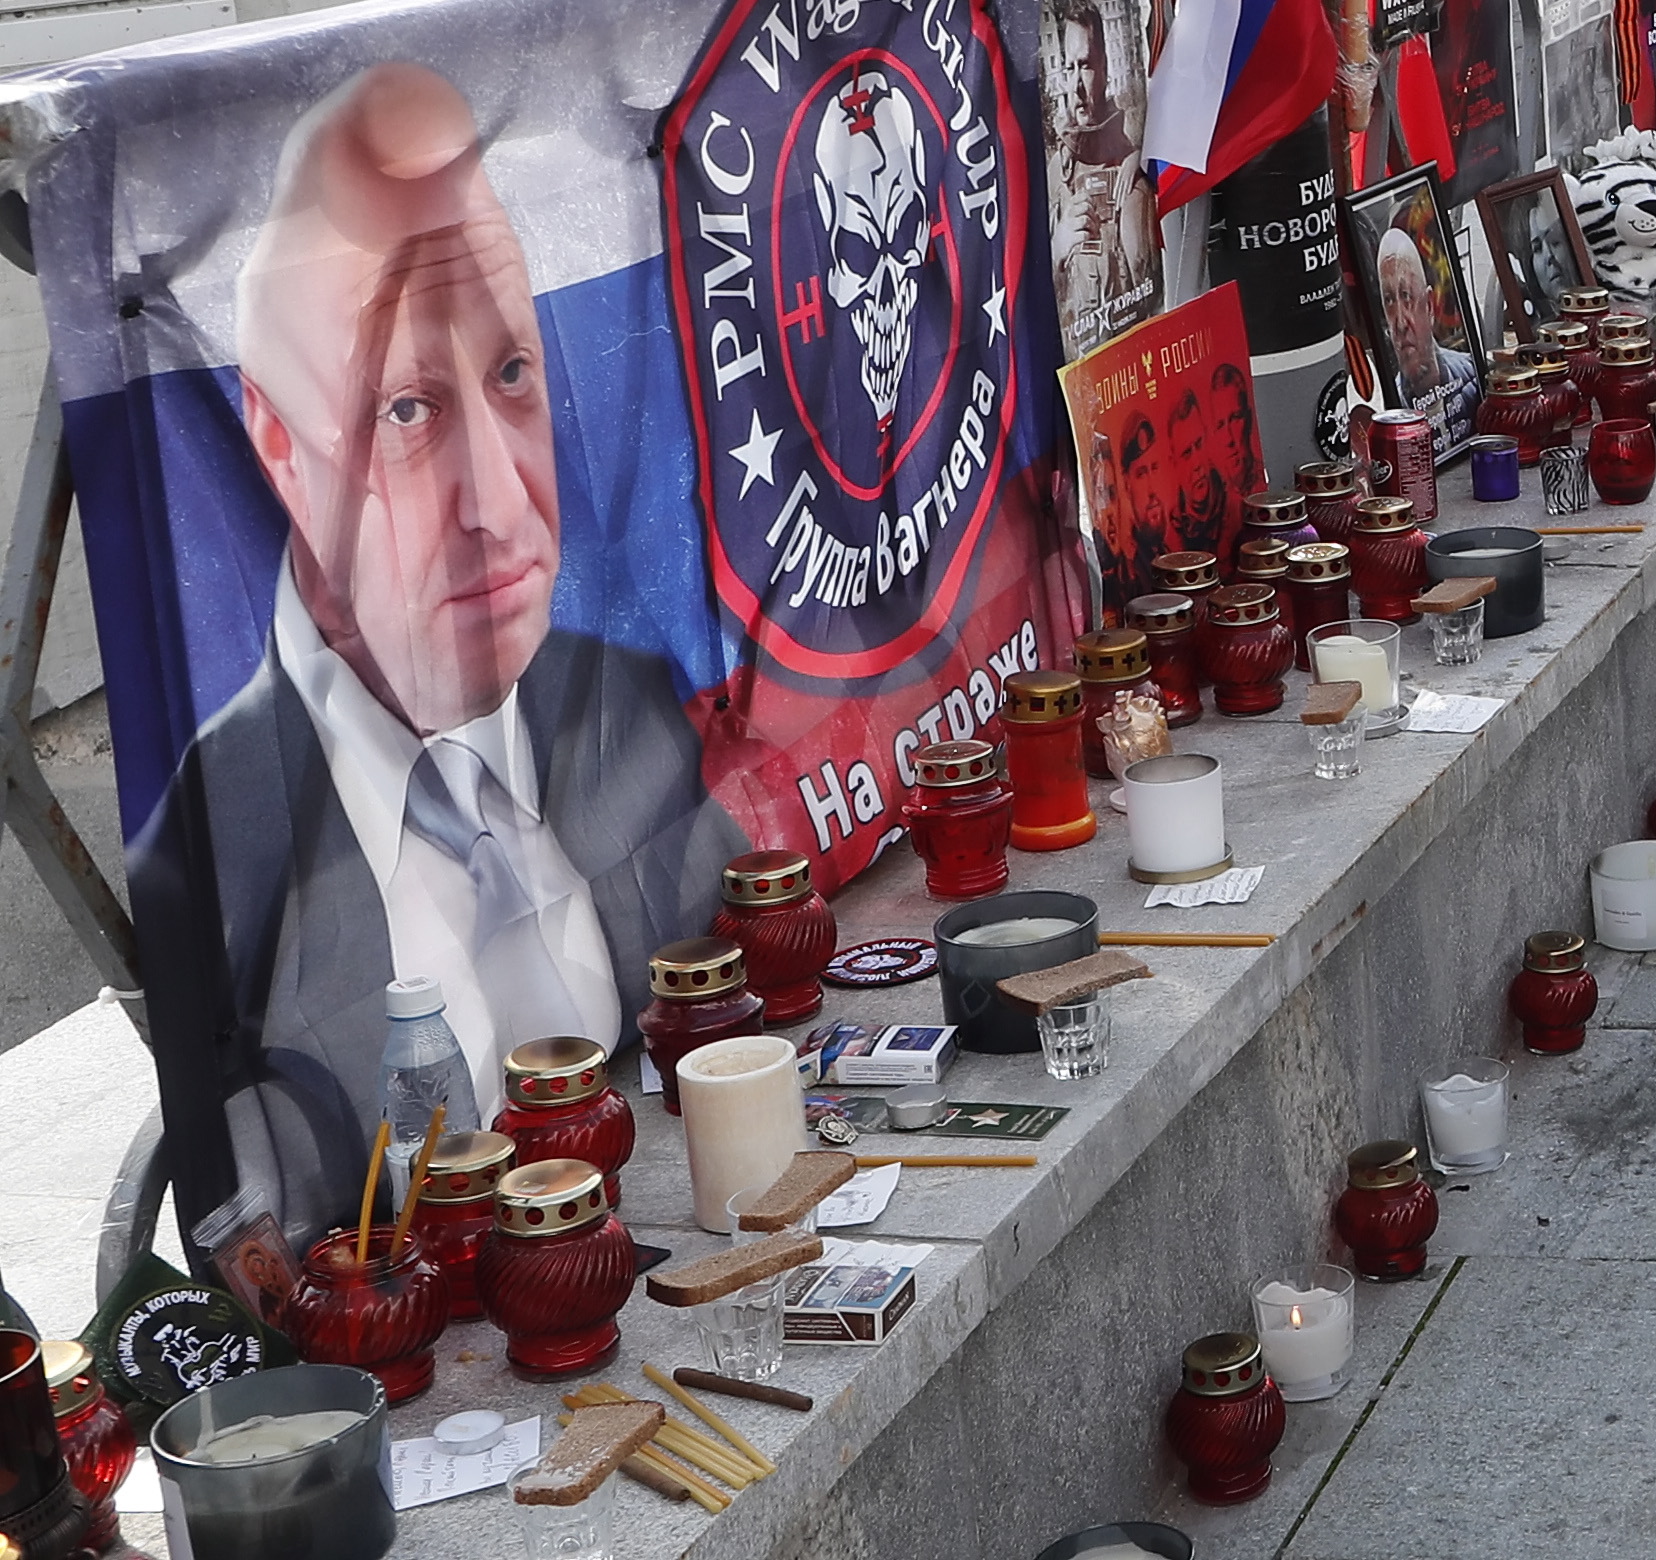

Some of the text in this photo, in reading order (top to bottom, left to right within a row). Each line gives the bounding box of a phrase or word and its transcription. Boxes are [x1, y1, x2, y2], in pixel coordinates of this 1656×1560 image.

[697, 111, 767, 401] PMC
[765, 368, 997, 610] Группа Вагнера
[799, 619, 1039, 854] На страже
[117, 1308, 152, 1378] МУЗЫКАНТЫ,
[146, 1289, 211, 1314] КОТОРЫХ
